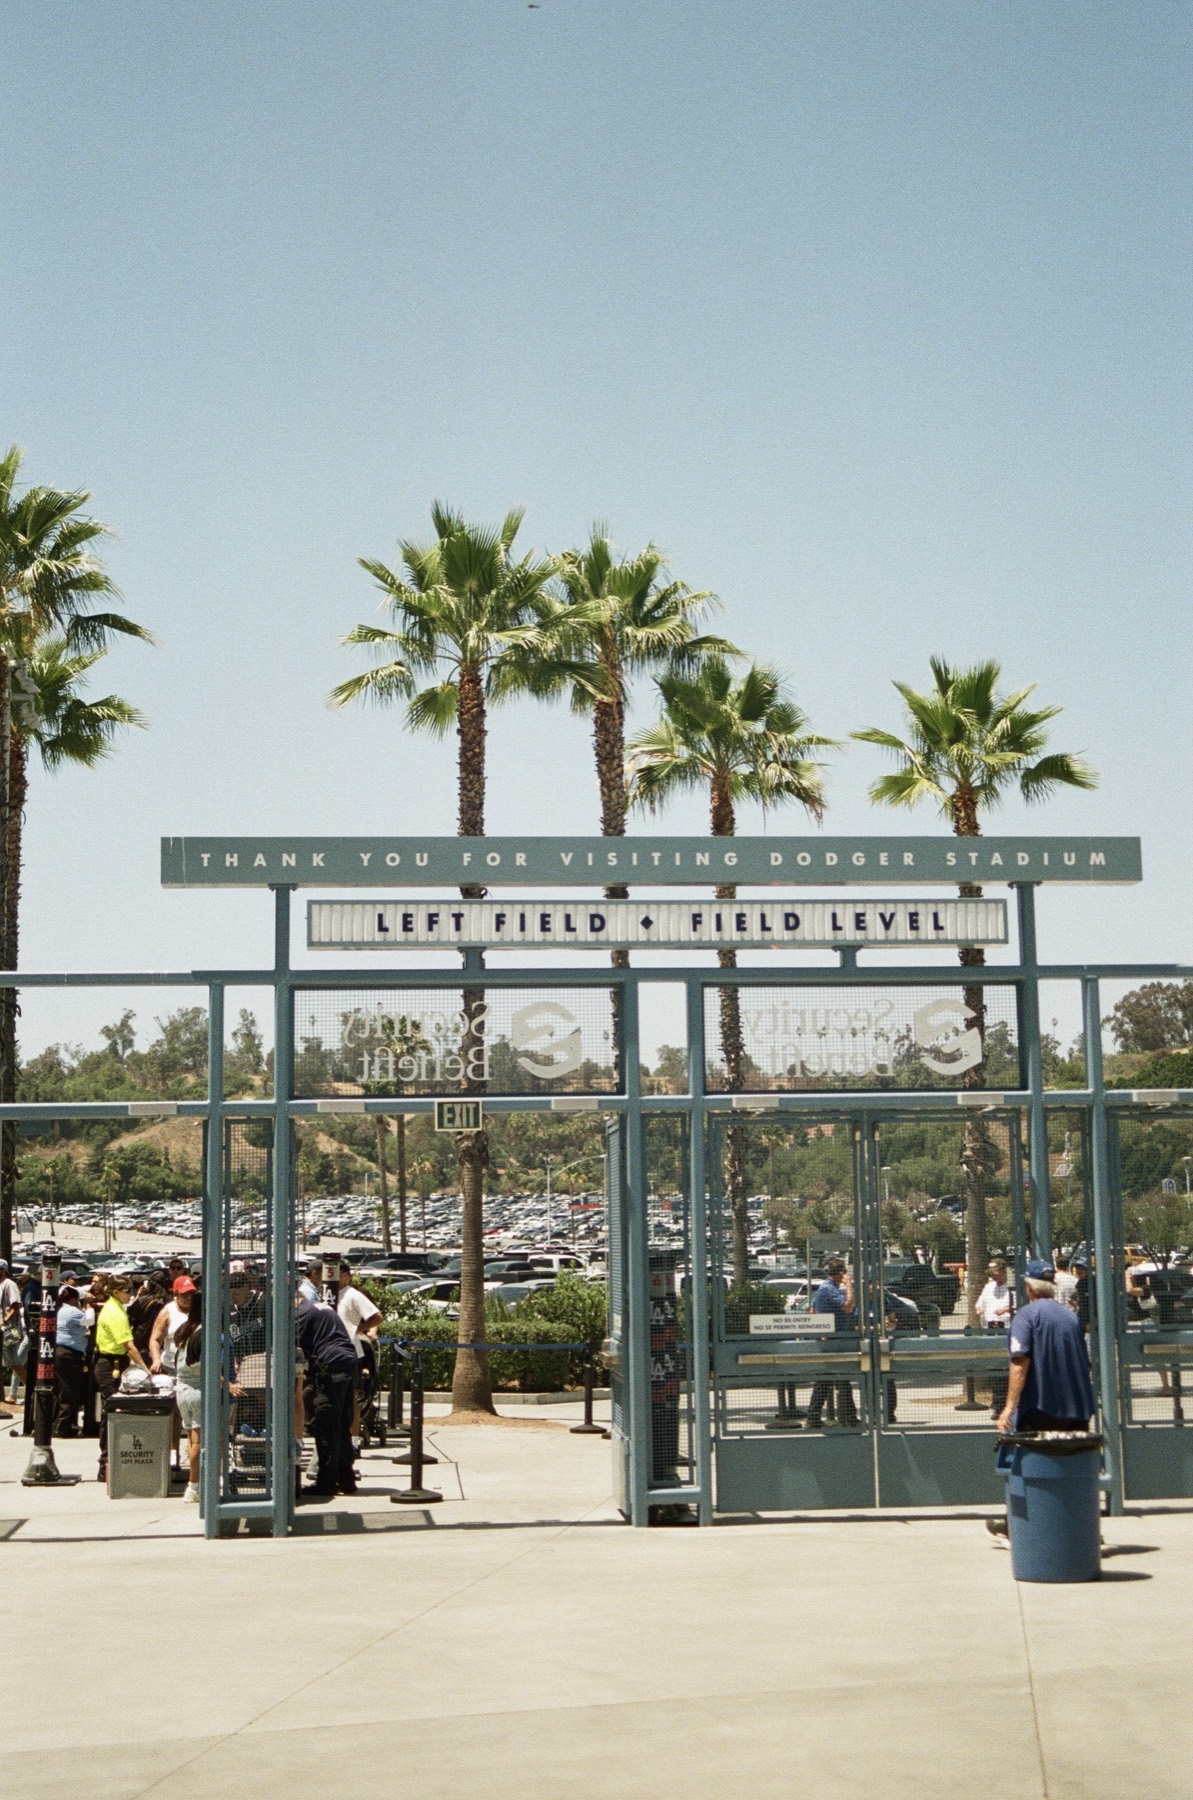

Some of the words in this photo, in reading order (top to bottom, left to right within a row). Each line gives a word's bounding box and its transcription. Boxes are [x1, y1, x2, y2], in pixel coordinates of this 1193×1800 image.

[200, 853, 325, 867] THANK
[359, 852, 428, 867] YOU
[463, 852, 527, 867] FOR
[560, 851, 738, 866] VISITING
[770, 852, 915, 866] DODGER
[946, 852, 1106, 866] STADIUM
[377, 912, 465, 933] LEFT
[495, 912, 606, 933] FIELD
[691, 912, 800, 932] FIELD
[831, 911, 945, 932] LEVEL
[443, 1103, 477, 1128] EXIT
[46, 1271, 54, 1280] 4
[327, 1267, 334, 1278] 5
[42, 1289, 56, 1311] LA
[322, 1284, 336, 1305] LA
[40, 1337, 54, 1359] LA
[132, 1435, 143, 1450] LA
[120, 1451, 155, 1459] SECURITY
